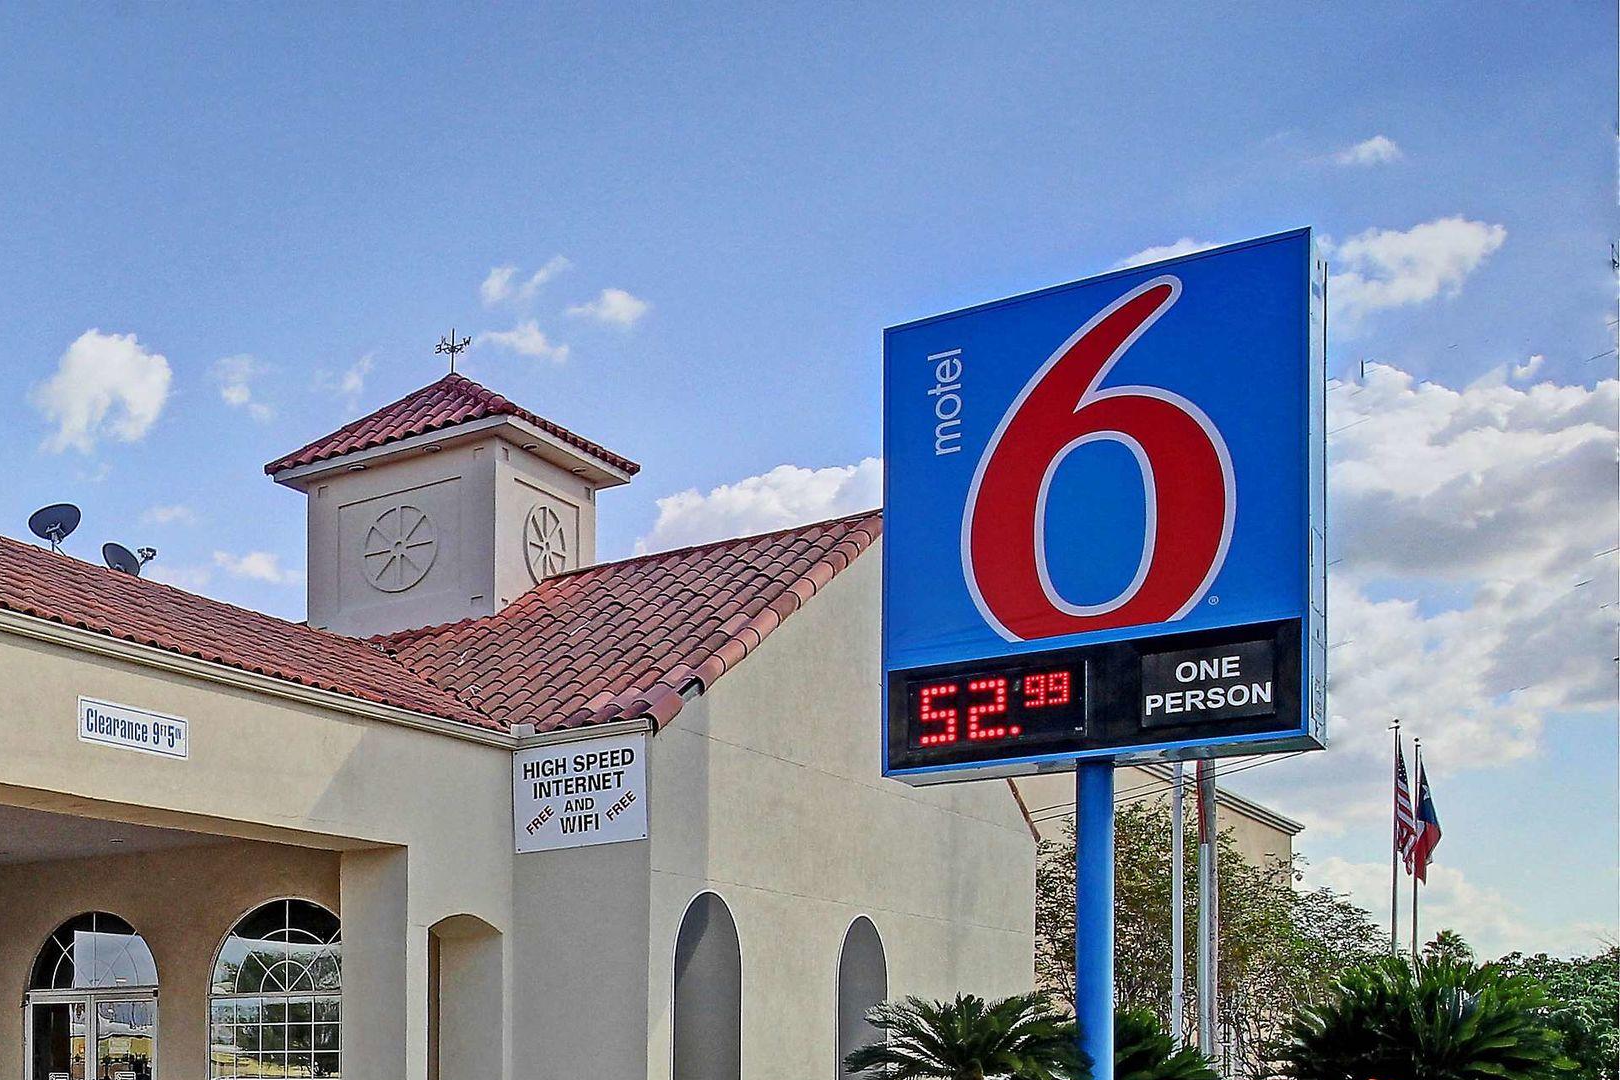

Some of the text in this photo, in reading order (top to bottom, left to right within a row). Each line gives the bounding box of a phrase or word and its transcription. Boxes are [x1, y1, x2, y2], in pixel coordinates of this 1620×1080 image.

[927, 275, 1237, 643] motel 6
[1175, 655, 1241, 683] ONE
[1145, 681, 1272, 716] PERSON
[86, 708, 148, 743] Clearance
[523, 748, 635, 780] HIGH SPEED
[533, 770, 625, 800] INTERNET
[526, 805, 555, 836] FREE
[564, 797, 595, 813] AND
[605, 790, 637, 821] FREE
[560, 813, 600, 835] WIFI
